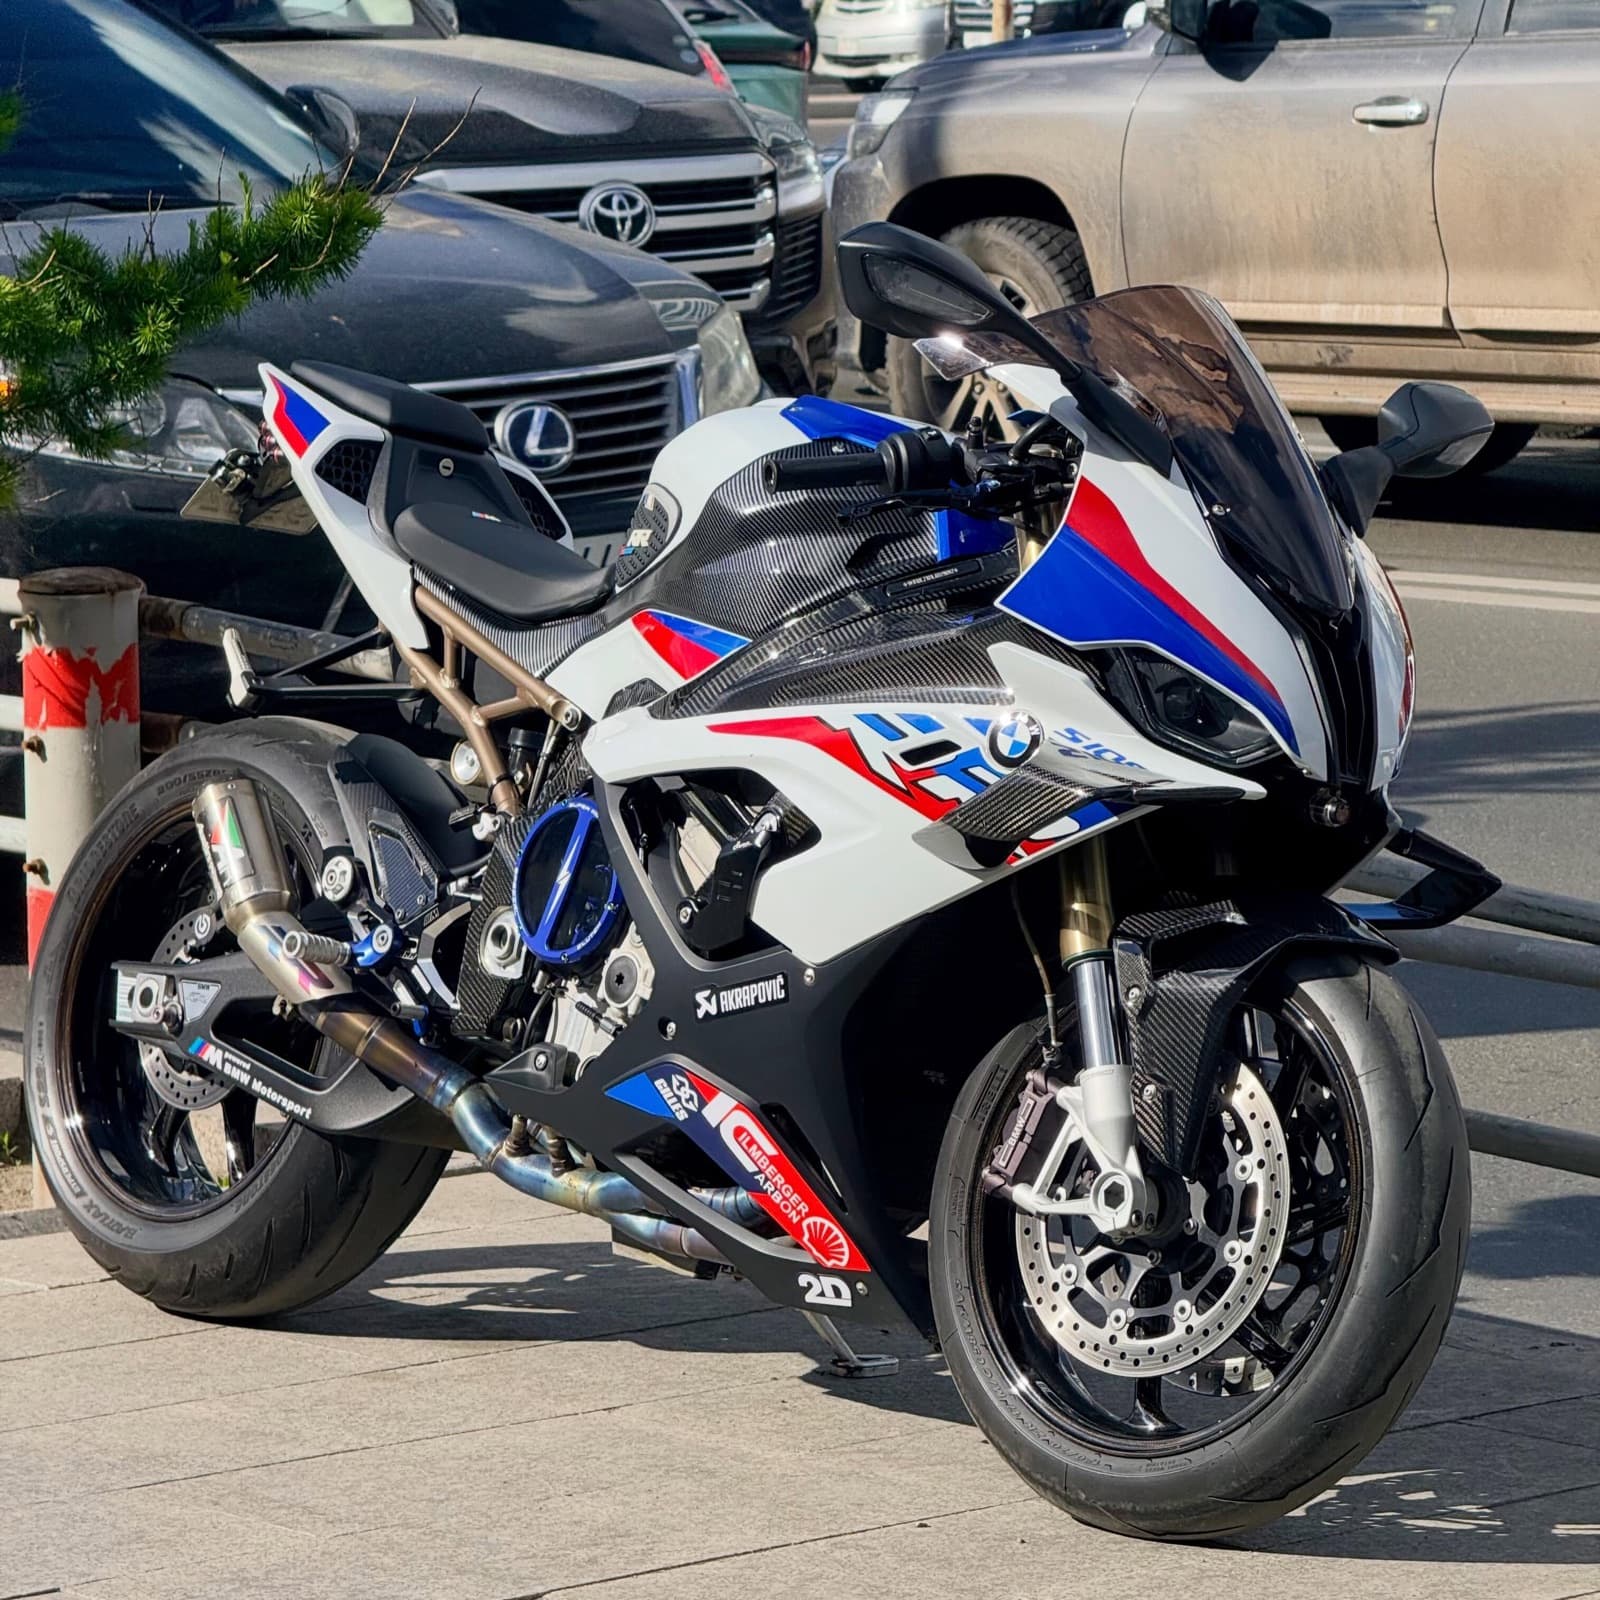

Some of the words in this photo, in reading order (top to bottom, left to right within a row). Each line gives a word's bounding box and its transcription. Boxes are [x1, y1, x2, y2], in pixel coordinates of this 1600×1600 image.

[223, 1061, 251, 1086] BMW
[252, 1077, 313, 1120] Motorsport
[737, 1131, 810, 1218] ILMBERGER
